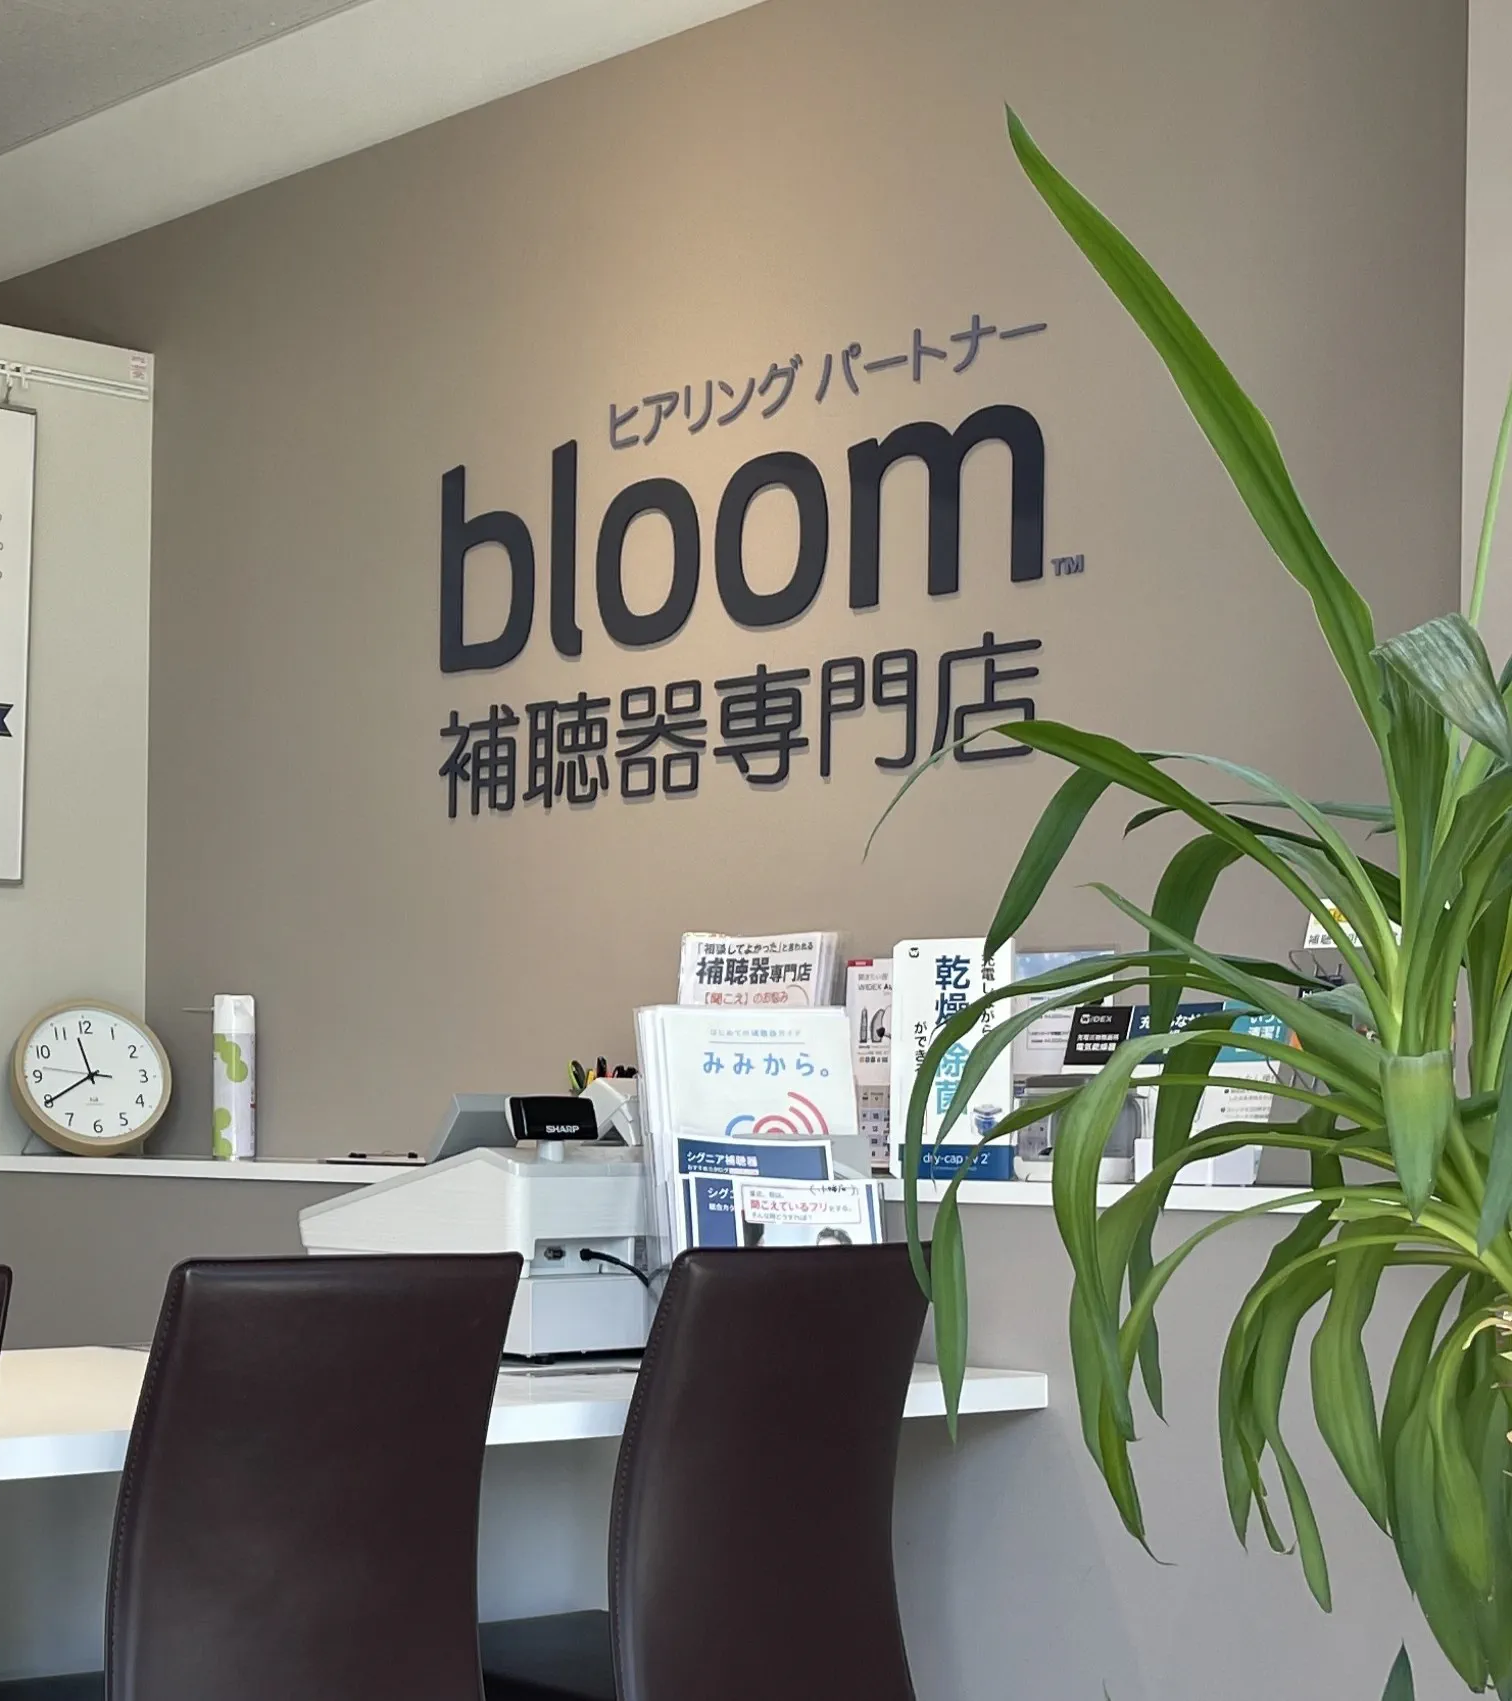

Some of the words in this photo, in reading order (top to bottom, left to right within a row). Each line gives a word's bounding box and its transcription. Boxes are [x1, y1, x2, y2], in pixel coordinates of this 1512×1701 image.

[608, 353, 803, 450] ヒアリング
[815, 314, 1048, 402] パートナー
[440, 404, 1045, 674] bloom
[439, 631, 1043, 820] 補聴器専門店
[695, 957, 813, 985] 補聴器専門店
[53, 1027, 67, 1040] 11
[78, 1020, 93, 1035] 12
[35, 1045, 51, 1059] 10
[128, 1045, 138, 1059] 2
[703, 1051, 829, 1077] みみから。
[32, 1069, 43, 1084] 9
[139, 1069, 149, 1083] 3
[43, 1093, 54, 1109] 8
[135, 1094, 145, 1108] 4
[64, 1112, 74, 1127] 7
[93, 1119, 103, 1134] 6
[118, 1112, 129, 1126] 5
[545, 1125, 579, 1133] SHARP
[687, 1151, 758, 1168] シグニア補聴器
